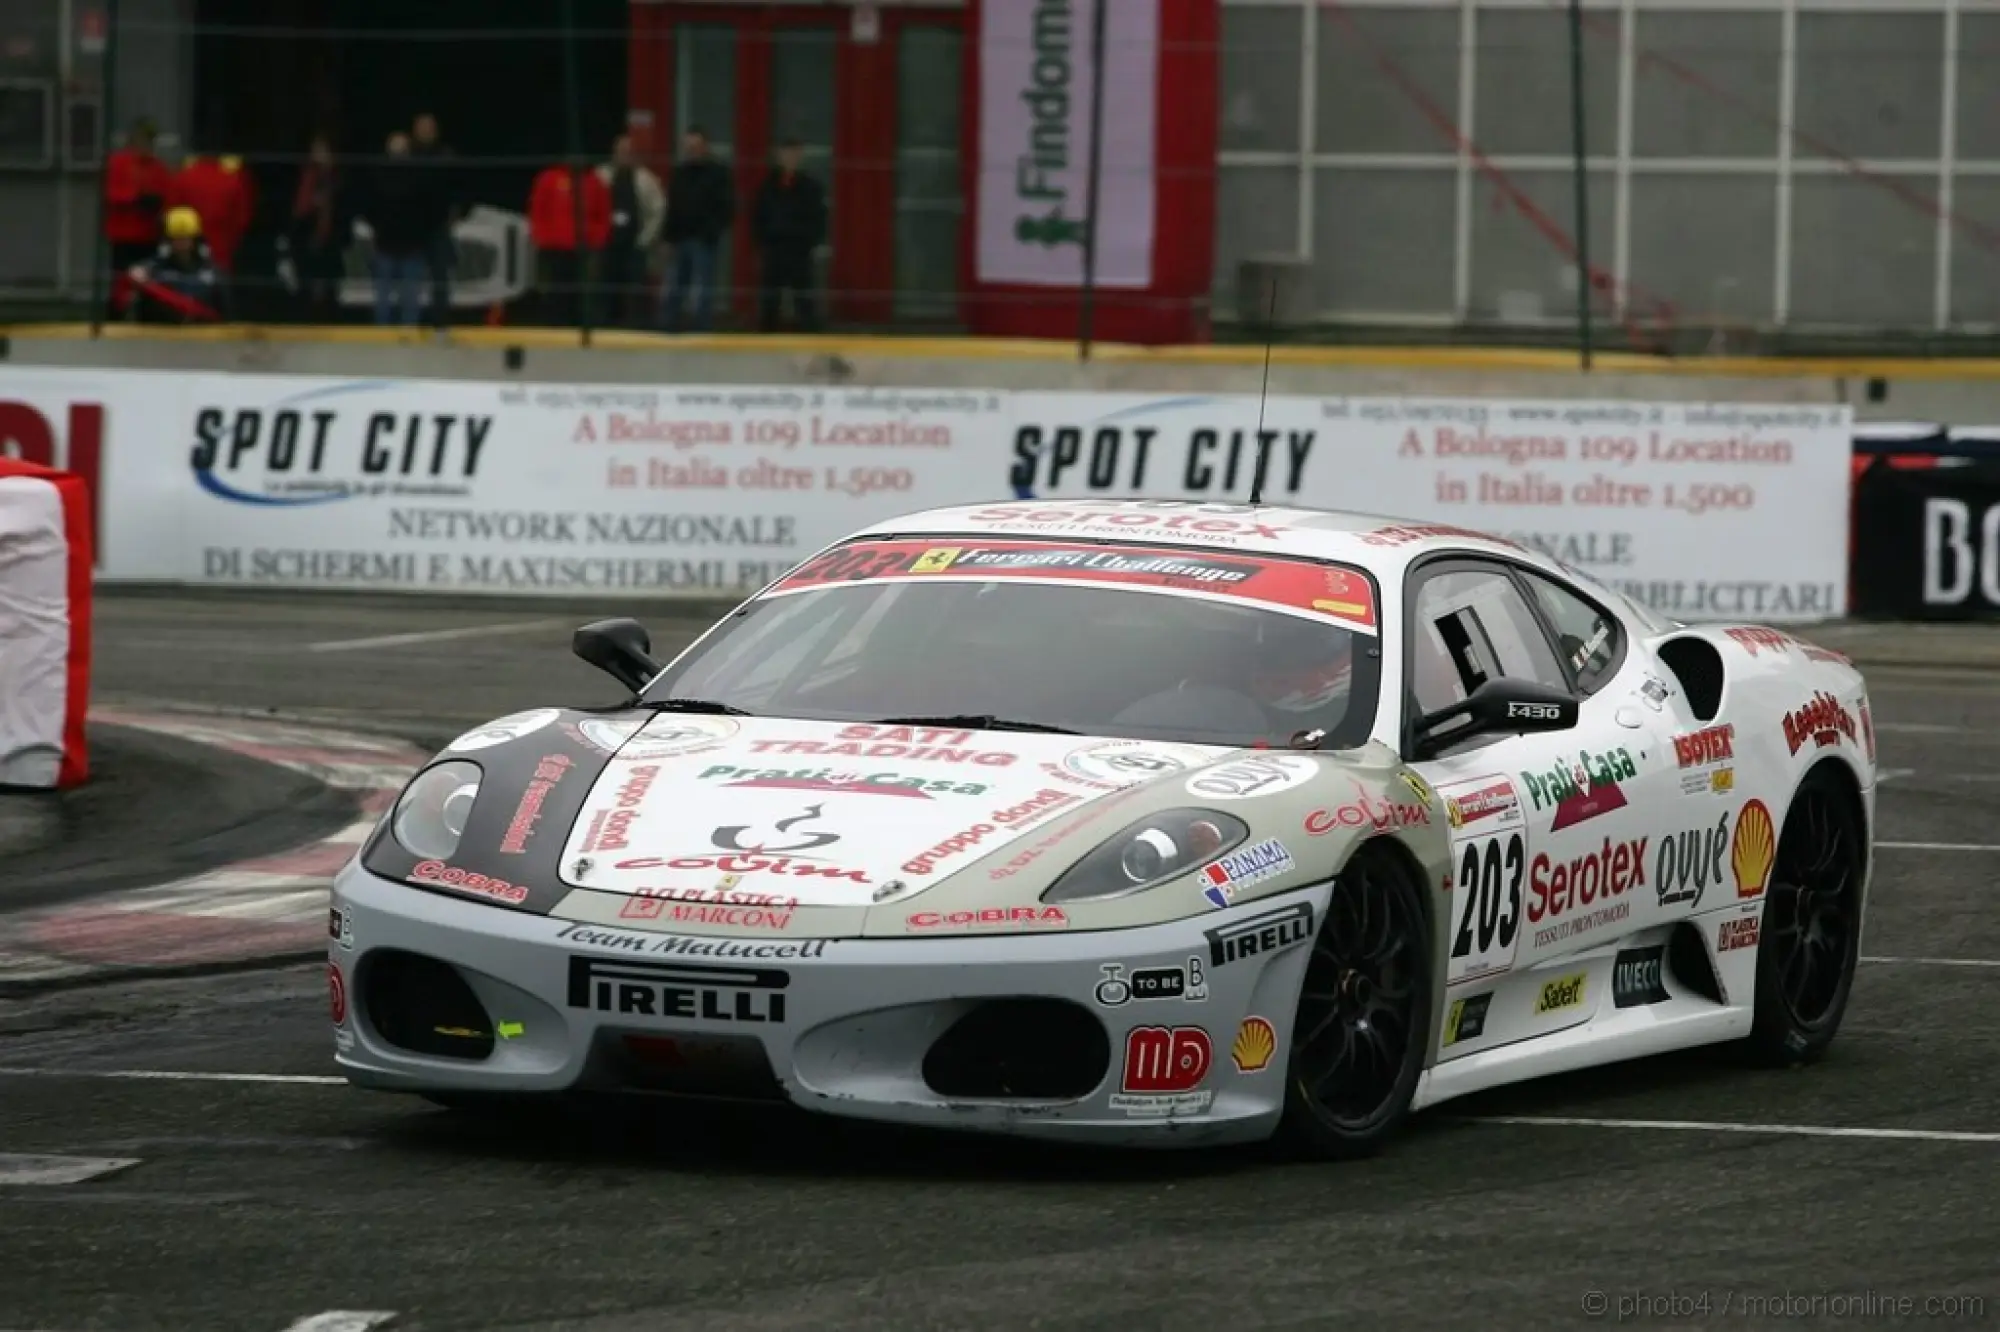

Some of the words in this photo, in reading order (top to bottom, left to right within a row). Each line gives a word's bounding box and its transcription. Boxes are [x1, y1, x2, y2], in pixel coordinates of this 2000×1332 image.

[190, 408, 337, 472] SPOT
[362, 413, 493, 476] CITY
[573, 414, 598, 443] A
[607, 412, 731, 449] Bologna
[745, 415, 800, 449] 109
[812, 415, 951, 447] Location
[1400, 429, 1424, 456] A
[1434, 427, 1566, 463] Bologna
[1580, 432, 1637, 466] 109
[1650, 431, 1792, 465] Location
[607, 458, 637, 488] in
[646, 457, 728, 489] Italia
[737, 458, 813, 490] oltre
[825, 467, 914, 494] 1.500
[1010, 425, 1159, 490] SPOT
[1183, 430, 1317, 493] CITY
[0, 399, 107, 570] I
[1435, 472, 1467, 502] in
[1479, 473, 1562, 505] Italia
[1572, 474, 1650, 507] oltre
[1664, 483, 1756, 511] 1.500
[387, 508, 574, 542] NETWORK
[585, 512, 797, 546] NAZIONALE
[969, 507, 1291, 540] Serotex
[1081, 523, 1238, 545] PRONTOMODA
[204, 547, 241, 578] DI
[251, 549, 416, 581] SCHERMI
[428, 552, 451, 582] E
[460, 553, 725, 588] MAXISCHERMI
[955, 548, 1088, 566] Ferrari
[1083, 552, 1248, 581] Challenge
[1507, 701, 1562, 720] F430
[752, 739, 1019, 767] TRADING
[835, 725, 975, 746] SATI
[697, 764, 834, 781] Prati
[858, 772, 988, 797] Casa
[1520, 757, 1579, 812] Prati
[1580, 747, 1638, 787] Casa
[901, 823, 995, 876] gruppo
[1220, 838, 1291, 882] PANAMA
[411, 859, 529, 902] COBRA
[1450, 833, 1525, 959] 203
[1527, 835, 1649, 923] Serotex
[666, 904, 791, 931] MARCONI
[681, 888, 801, 910] PLASTICA
[906, 906, 1067, 929] COBRA
[556, 921, 645, 951] Team
[1203, 901, 1315, 968] PIRELLI
[567, 955, 790, 1022] PIRELLI
